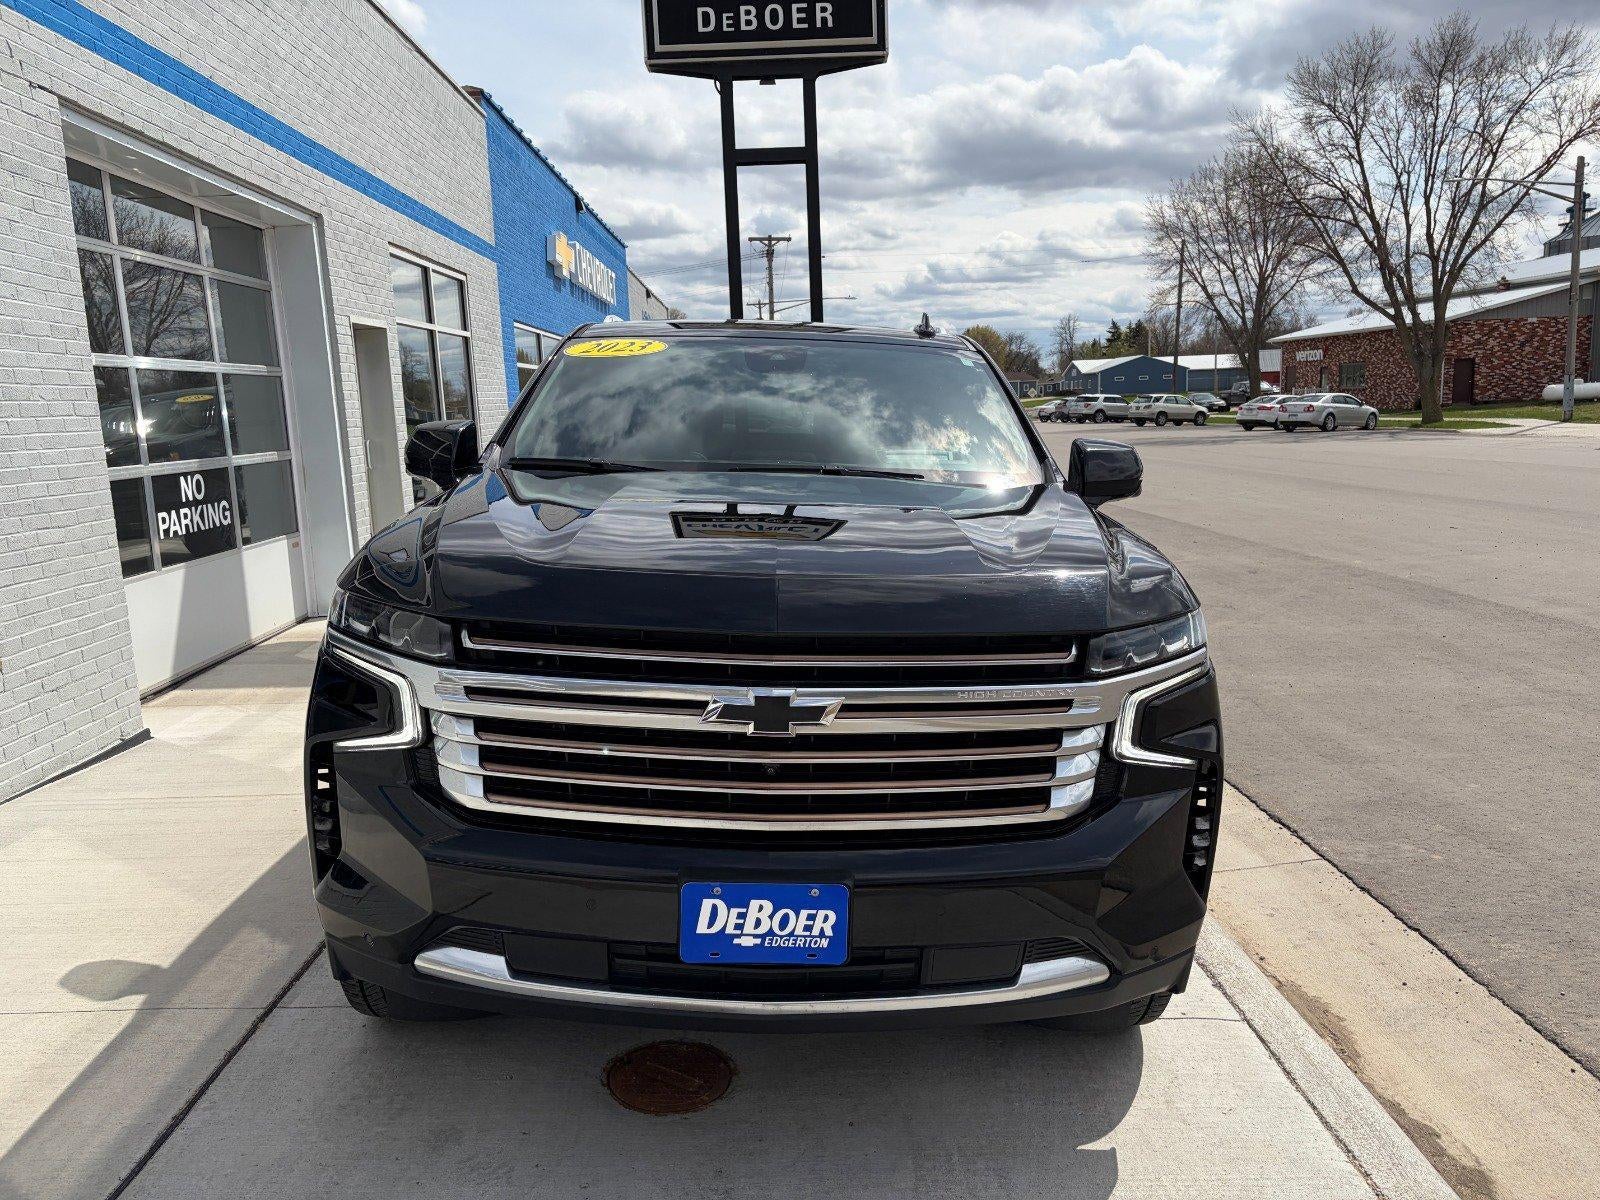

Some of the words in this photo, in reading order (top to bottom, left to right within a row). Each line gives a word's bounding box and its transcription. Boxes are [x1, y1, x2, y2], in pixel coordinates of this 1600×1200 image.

[579, 341, 653, 354] 2023
[1296, 349, 1323, 361] verizon
[180, 473, 205, 502] NO
[157, 500, 232, 540] PARKING
[957, 691, 997, 699] HIGH
[1002, 688, 1077, 699] COUNTRY
[764, 936, 830, 949] EDGERTON
